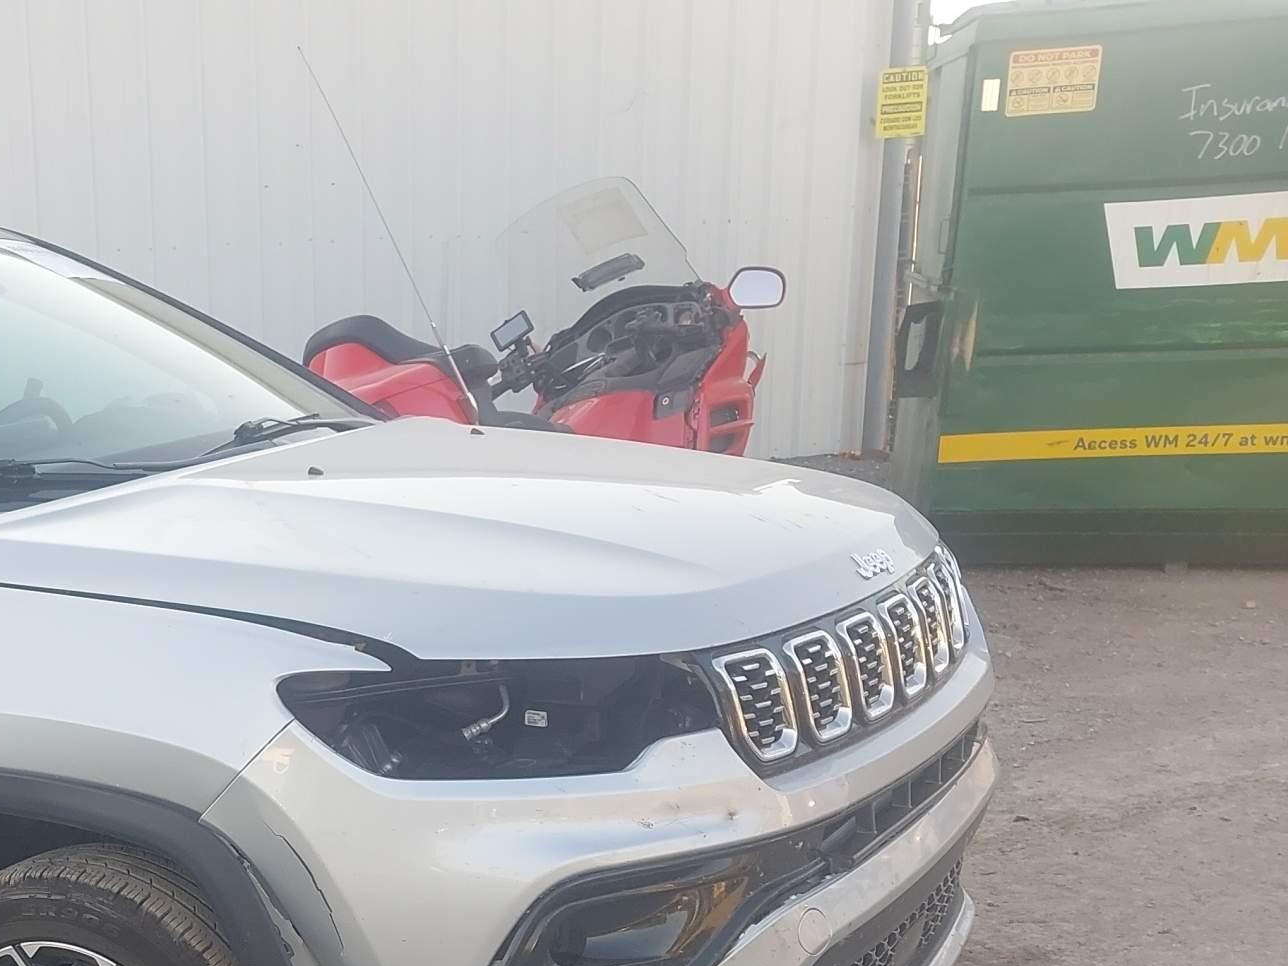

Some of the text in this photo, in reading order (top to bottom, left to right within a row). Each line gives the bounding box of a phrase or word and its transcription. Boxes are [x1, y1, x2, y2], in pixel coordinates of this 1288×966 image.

[1018, 51, 1092, 63] DO NOT PARK
[1189, 129, 1261, 160] 7300
[1133, 217, 1288, 268] WM
[1073, 436, 1138, 451] Access
[1144, 434, 1180, 449] WM
[1185, 432, 1234, 448] 24/7
[1238, 433, 1257, 447] at
